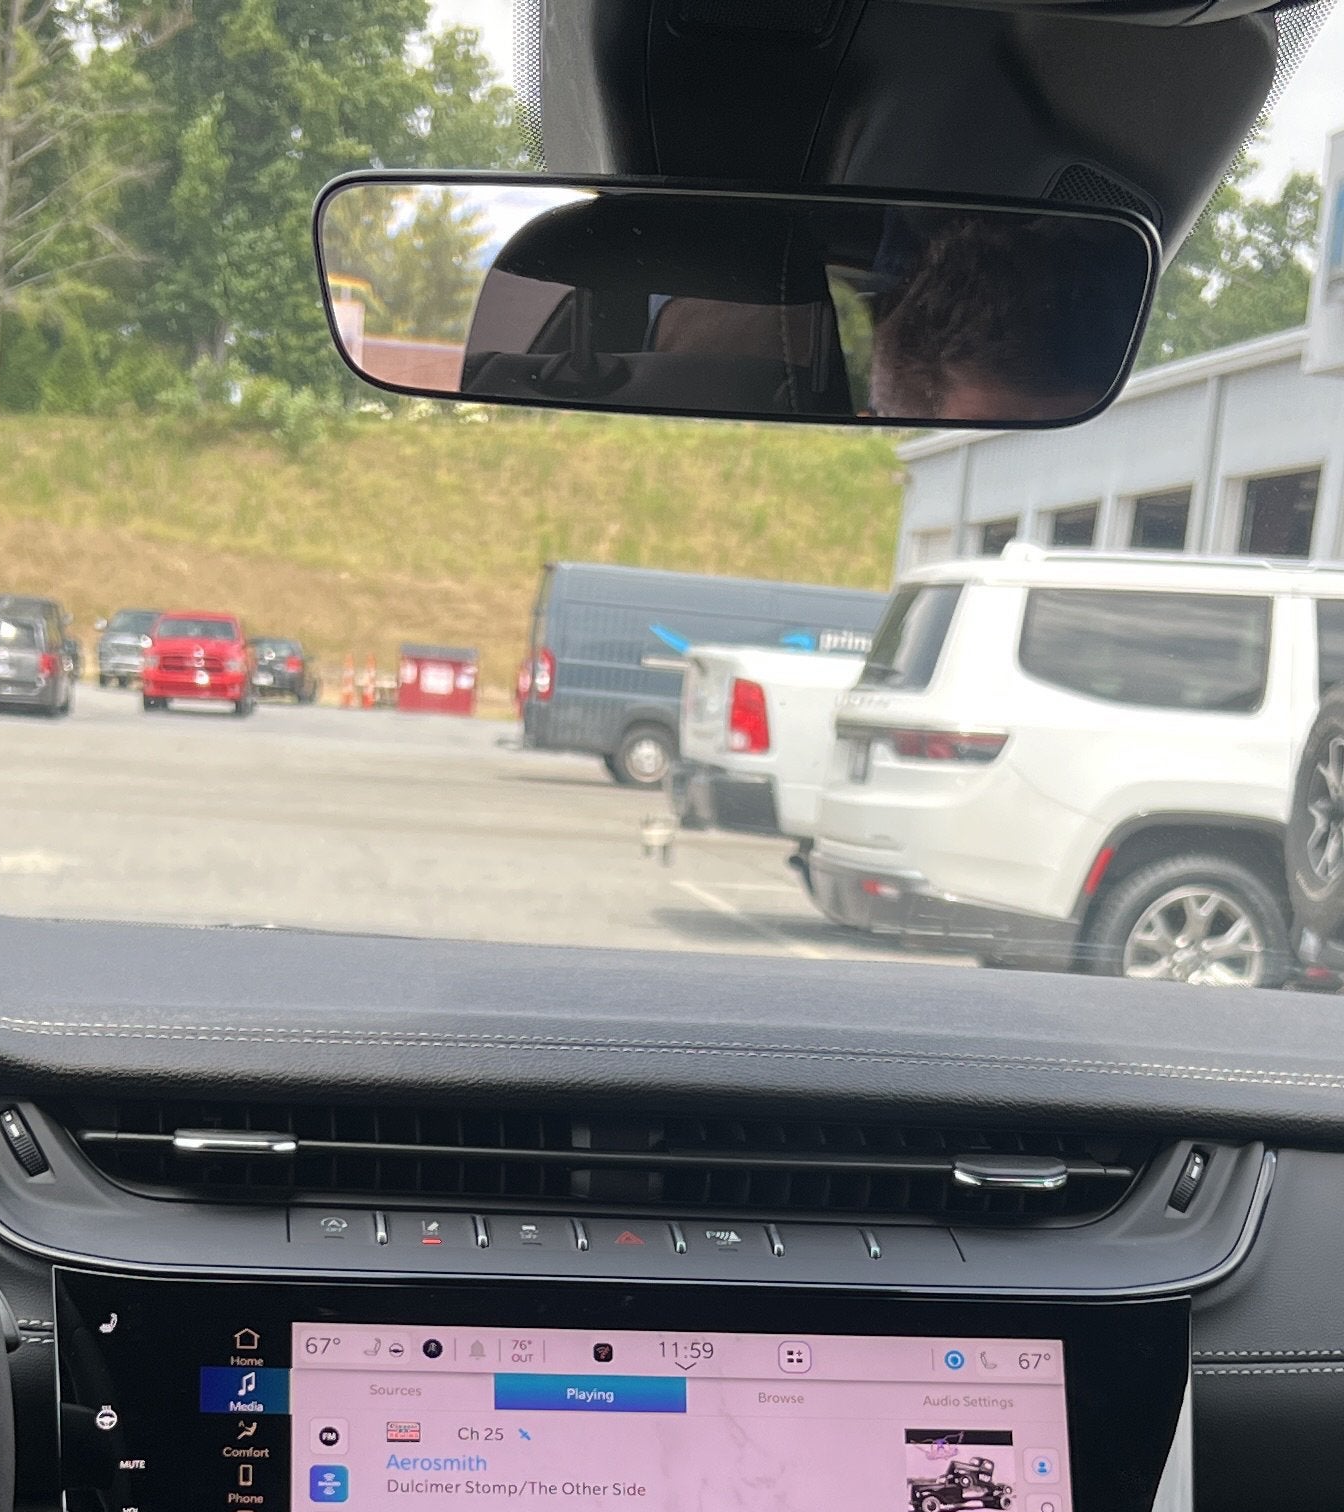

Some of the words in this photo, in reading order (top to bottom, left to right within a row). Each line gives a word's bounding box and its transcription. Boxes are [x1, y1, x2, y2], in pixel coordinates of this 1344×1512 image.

[305, 1337, 342, 1355] 67°
[511, 1339, 533, 1351] 76°
[658, 1341, 715, 1360] 11:59
[230, 1355, 264, 1367] Home
[511, 1353, 534, 1364] OUT
[1017, 1352, 1052, 1371] 67°
[369, 1383, 423, 1397] Sources
[566, 1386, 615, 1404] Playing
[757, 1391, 805, 1405] Browse
[922, 1394, 961, 1409] Audio
[963, 1394, 1014, 1411] Settings
[229, 1400, 264, 1412] Media
[457, 1426, 480, 1442] Ch
[484, 1426, 505, 1442] 25
[222, 1446, 270, 1458] Comfort
[119, 1460, 146, 1470] MUTE
[387, 1454, 488, 1473] Aerosmith
[387, 1479, 461, 1495] Dulcimer
[464, 1480, 559, 1498] Stomp/The
[562, 1481, 609, 1496] Other
[612, 1481, 647, 1497] Side
[228, 1492, 264, 1504] Phone
